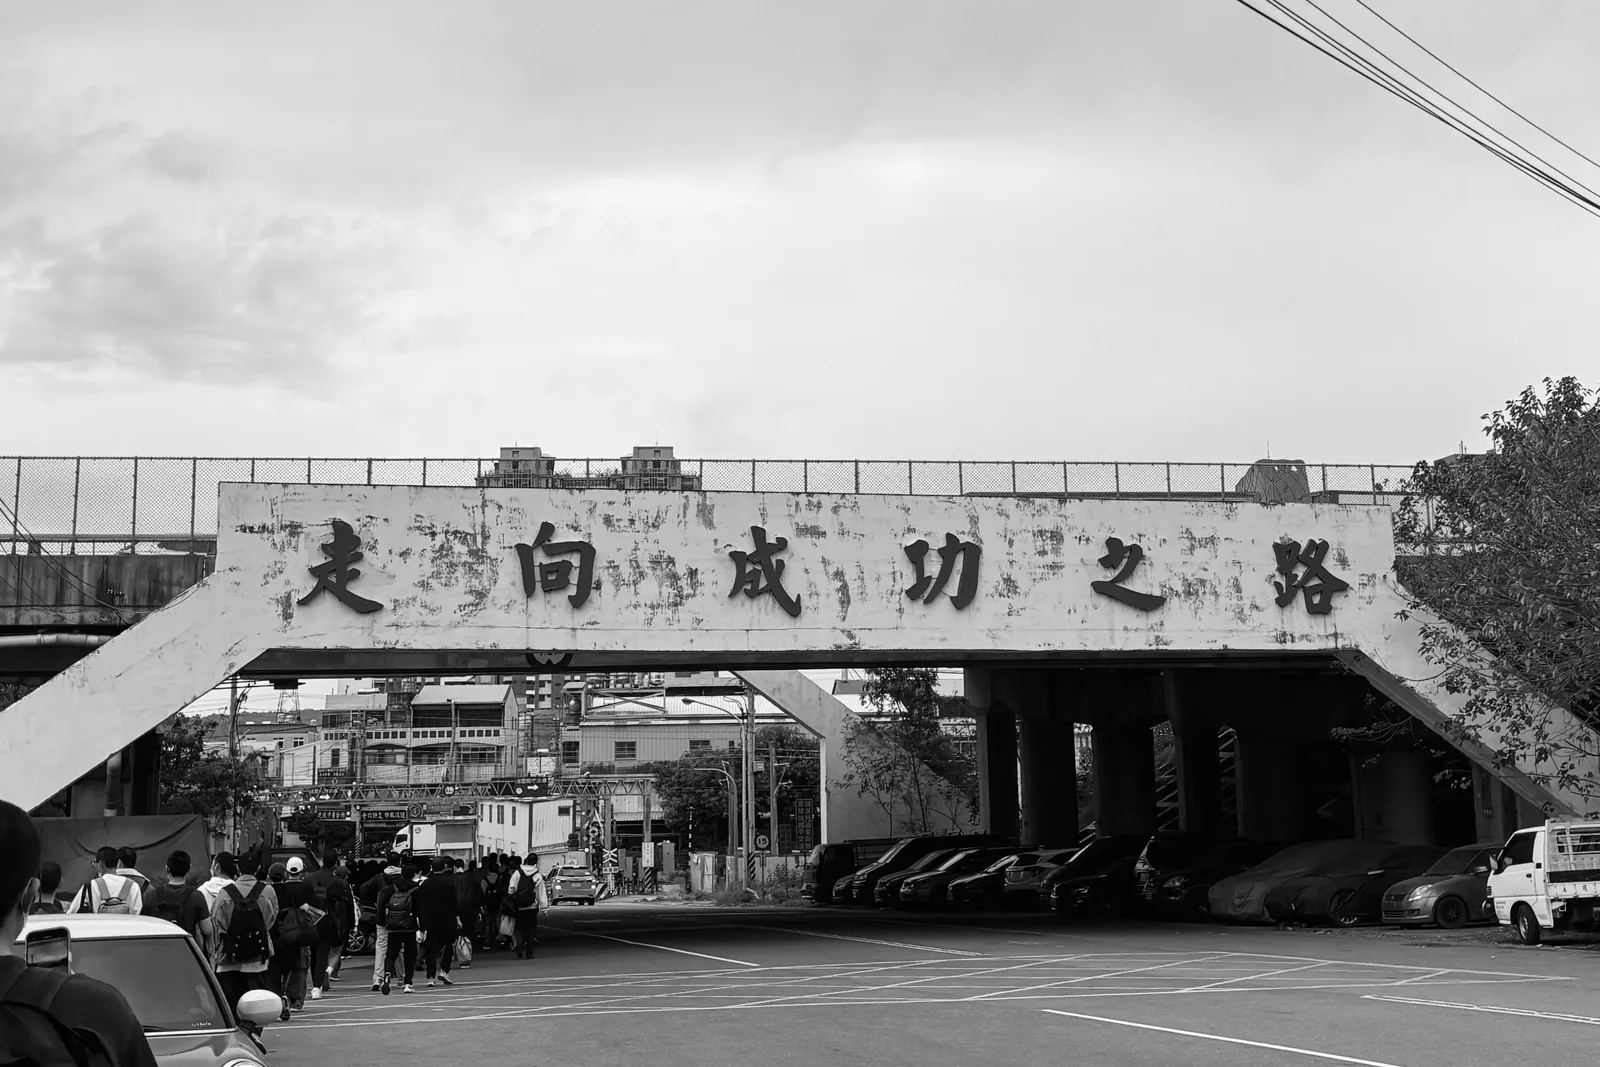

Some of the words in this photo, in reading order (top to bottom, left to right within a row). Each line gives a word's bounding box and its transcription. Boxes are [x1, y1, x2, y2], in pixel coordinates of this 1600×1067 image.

[297, 520, 1350, 617] 走向成功之路
